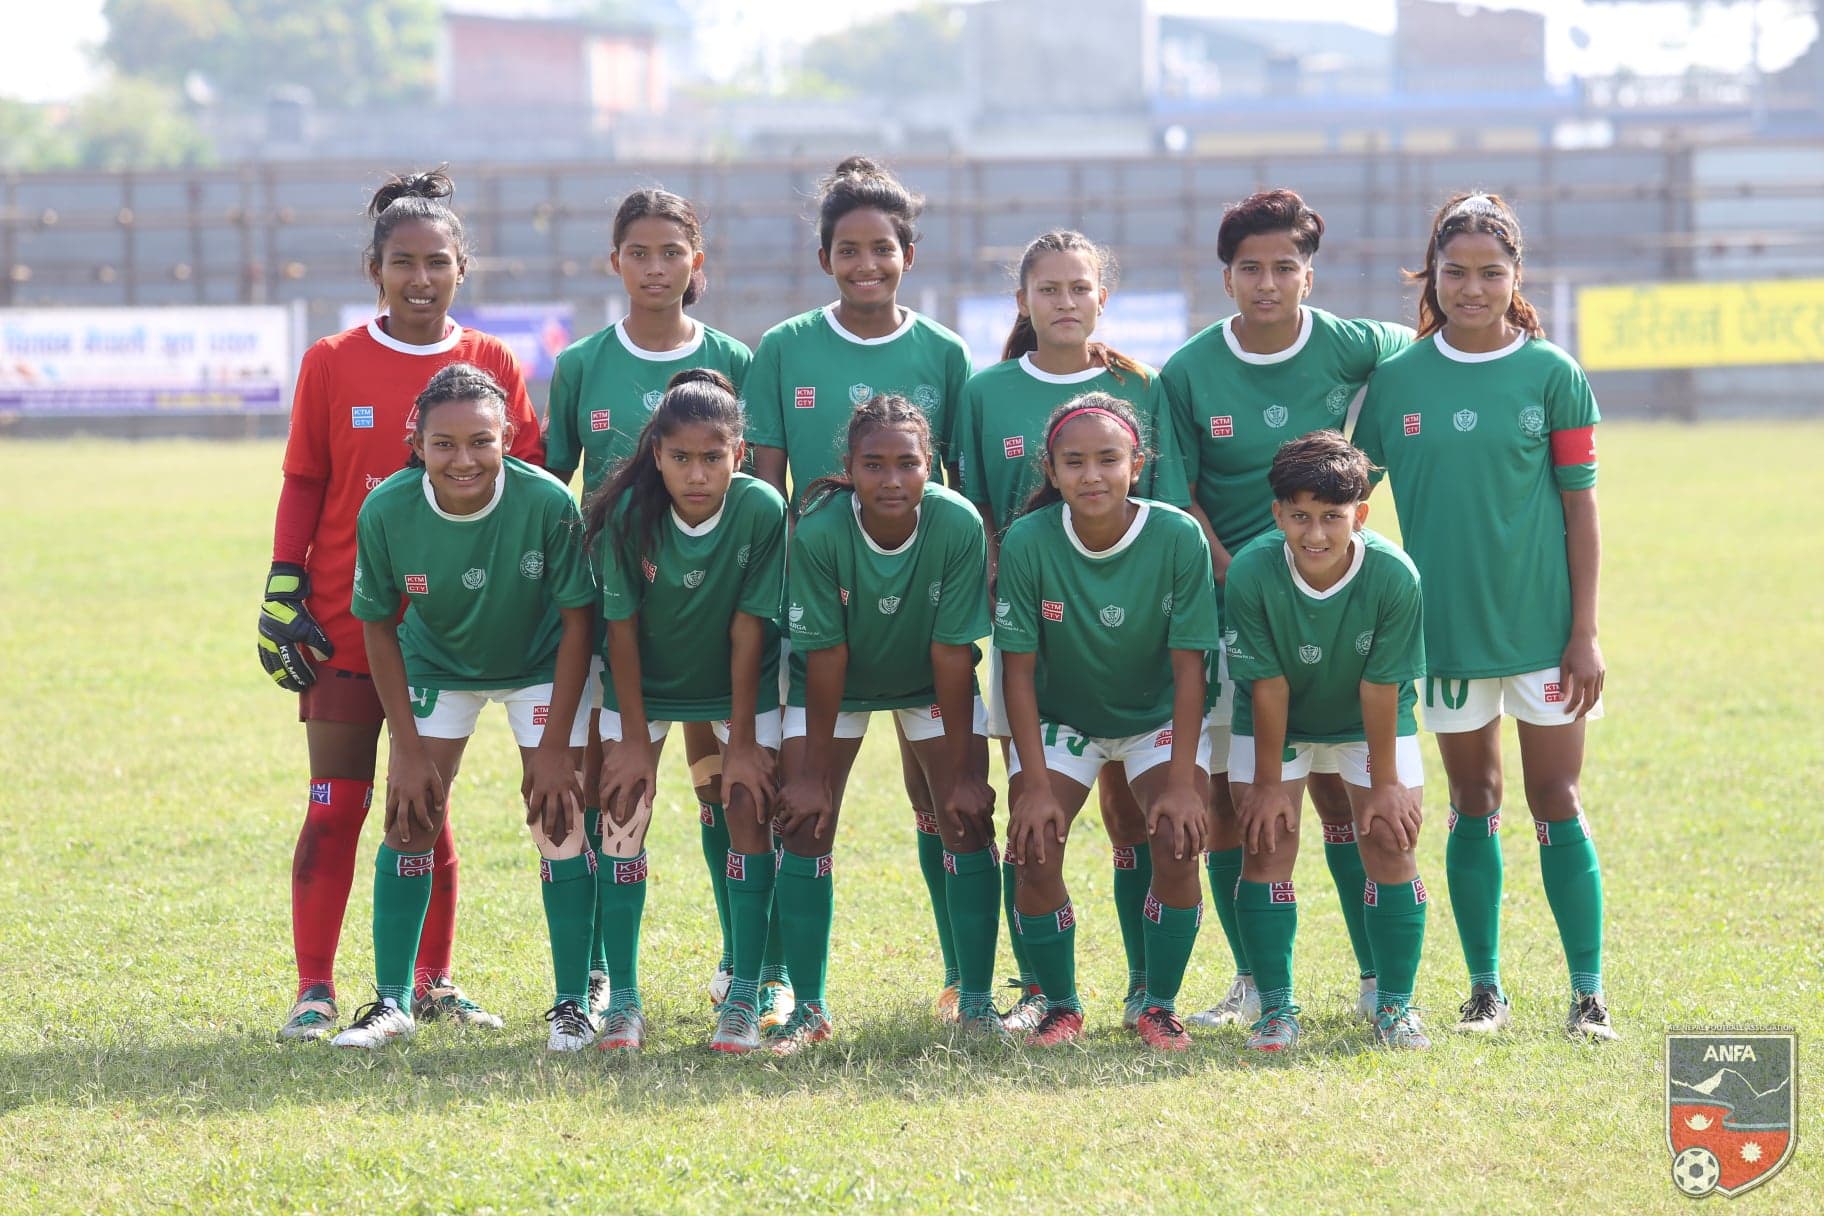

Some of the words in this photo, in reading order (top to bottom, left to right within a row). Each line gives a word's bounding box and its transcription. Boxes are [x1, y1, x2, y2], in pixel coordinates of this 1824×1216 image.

[1405, 415, 1419, 423] KTM
[1006, 438, 1022, 447] KTM
[1044, 603, 1062, 611] KTM
